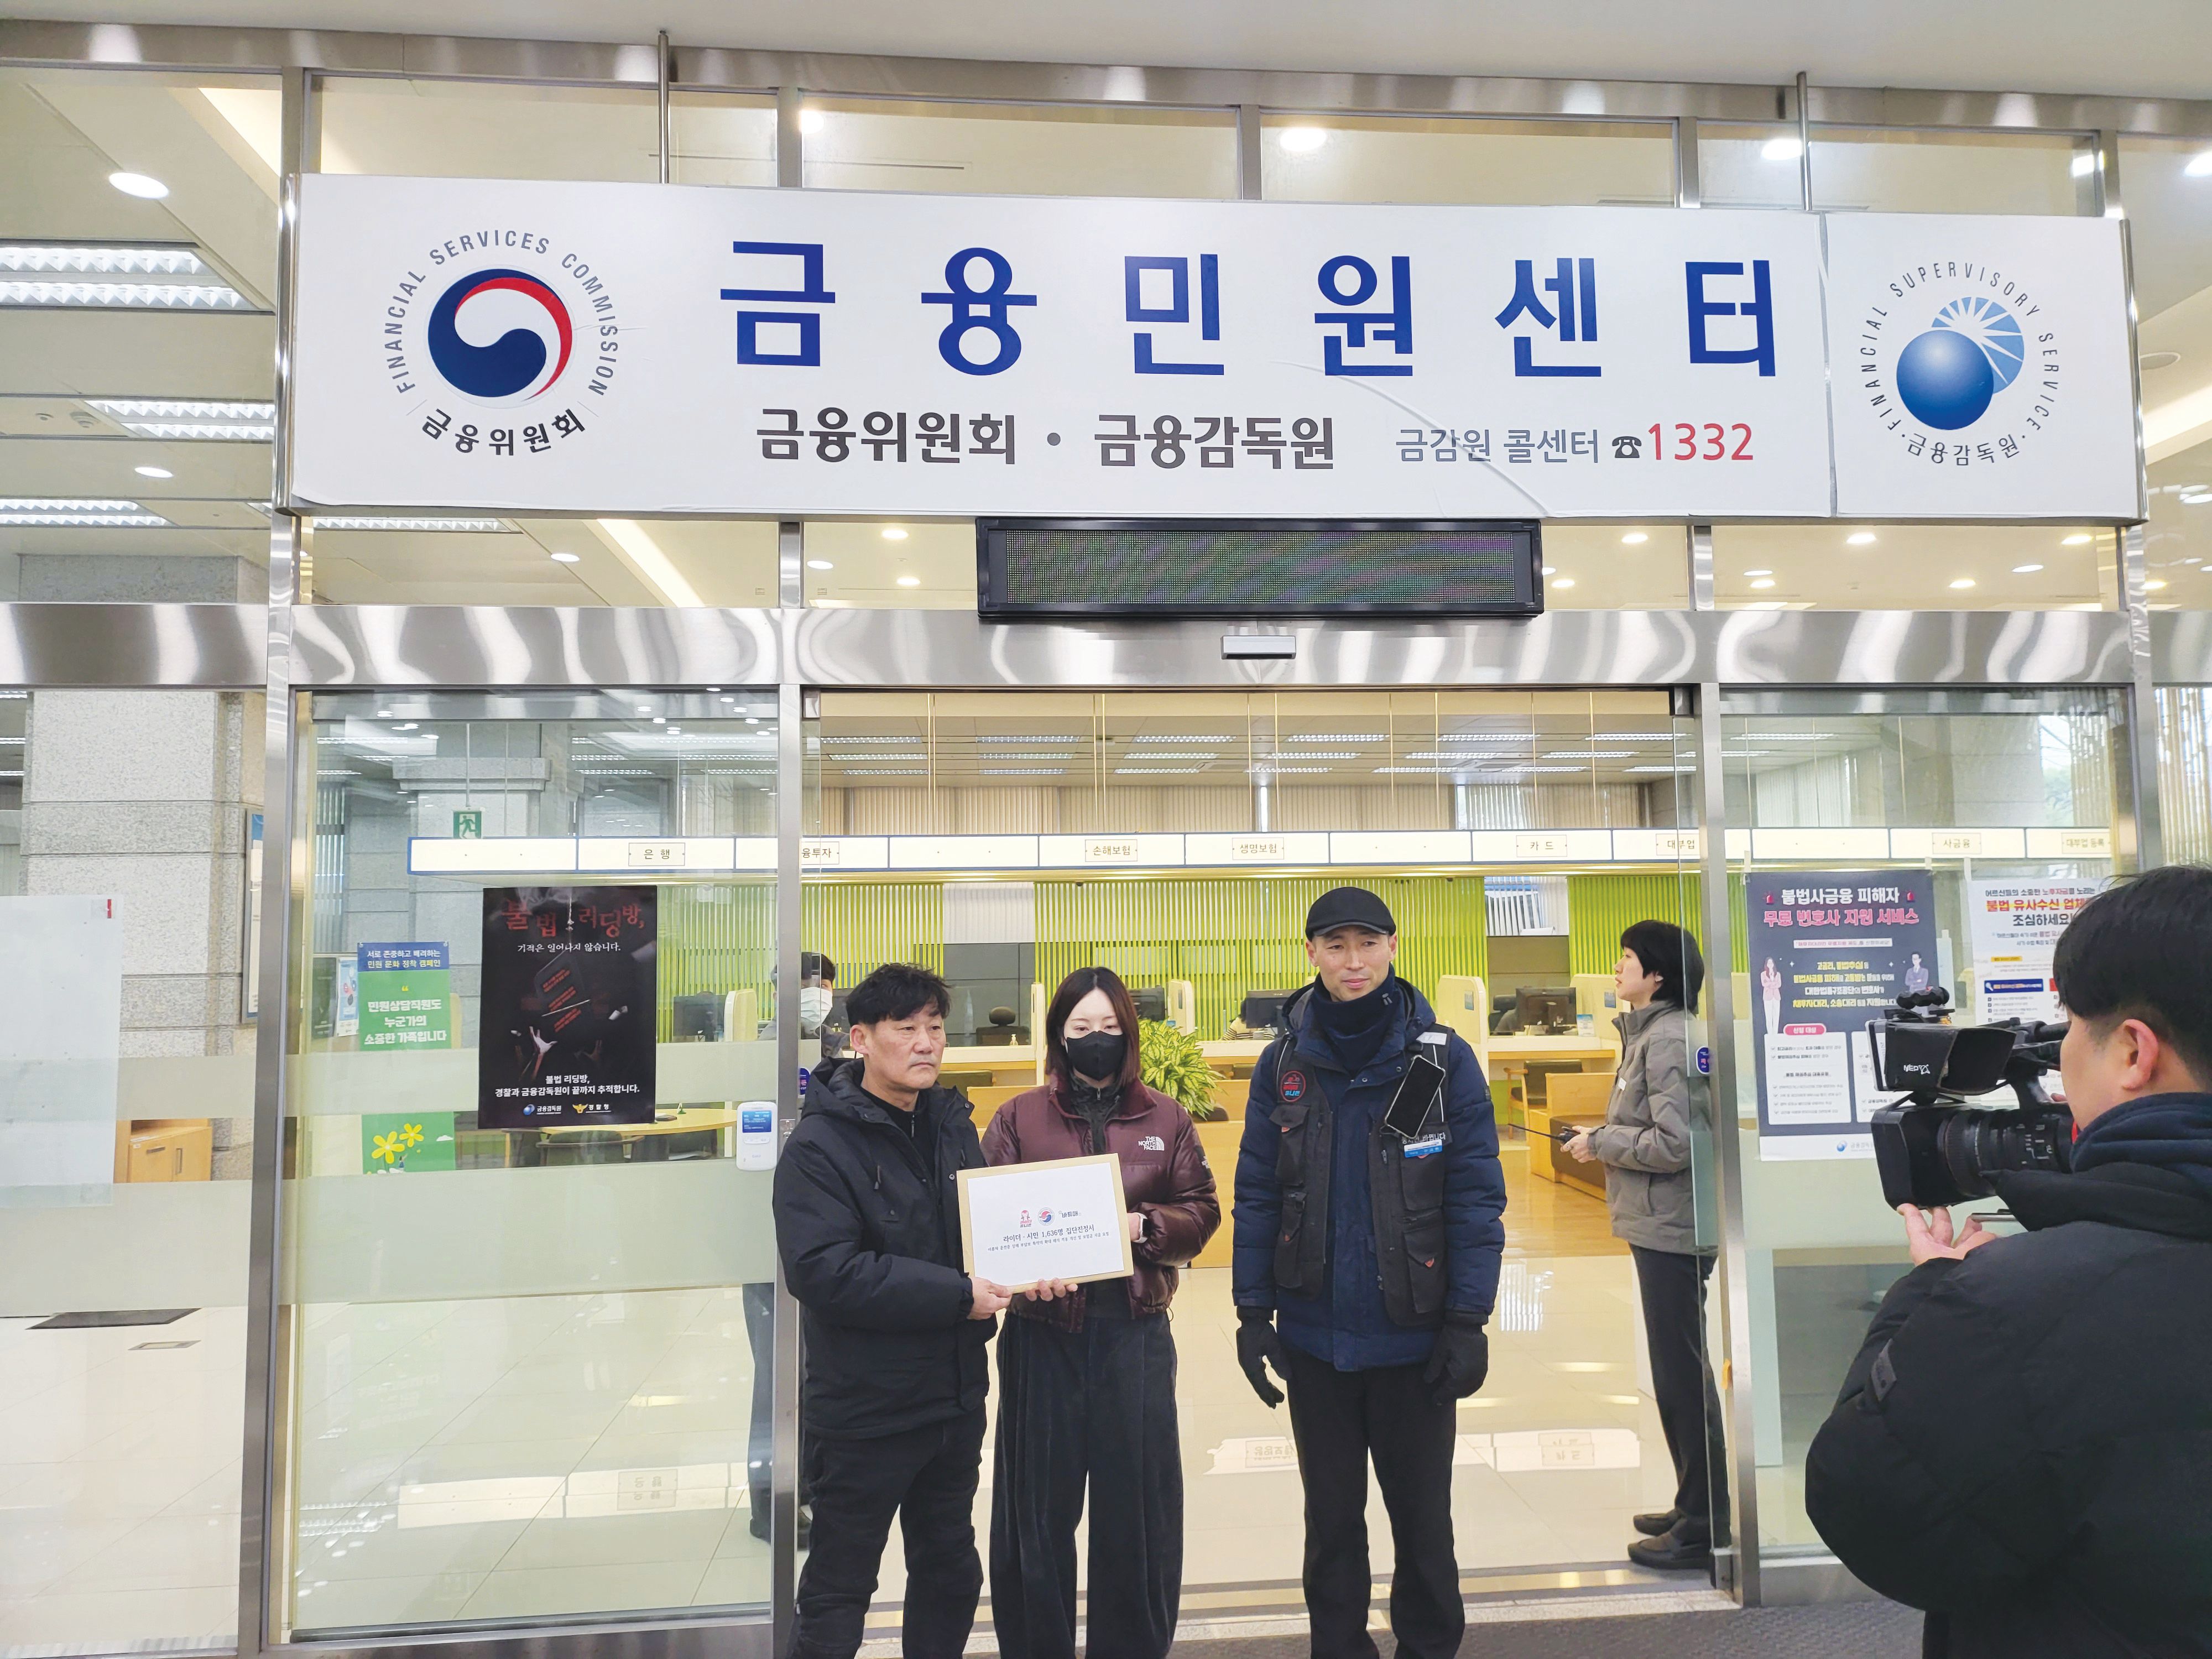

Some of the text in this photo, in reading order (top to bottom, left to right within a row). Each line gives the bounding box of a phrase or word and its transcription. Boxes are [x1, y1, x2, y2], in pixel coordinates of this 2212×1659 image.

[384, 229, 618, 398] FINANCIAL SERVICES COMMISSION
[720, 241, 1776, 377] 금융민원센터
[1860, 261, 2059, 431] FINANCIAL SUPERVISORY SERVICE
[421, 408, 586, 457] 금융위원회
[757, 406, 1016, 465] 금융위원회
[1094, 414, 1333, 470] 금융감독원
[1395, 422, 1754, 464] 금감원 콜센터 1332
[1907, 432, 2020, 466] 금융감독원
[1092, 844, 1131, 857] 손해보험
[1239, 842, 1278, 854] 생명보험
[1530, 839, 1555, 852] 카드
[1667, 839, 1695, 851] 대부업
[1943, 838, 1971, 849] 사금융
[643, 847, 671, 860] 은행
[801, 847, 832, 859] 융투자
[1781, 886, 1900, 905] 불법사금융 피해자
[1986, 900, 2010, 912] 불법
[2013, 898, 2060, 911] 유사수신
[502, 898, 556, 938] 불법
[1764, 908, 1919, 927] 무료 변호사 지원 서비스
[367, 950, 441, 958] 서로 존중하고 배려하는
[517, 942, 621, 953] 기적은 일어나지 않습니다.
[367, 999, 442, 1013] 민원상담직원도
[384, 1015, 427, 1028] 누군가의
[364, 1030, 447, 1045] 소중한 가족입니다
[545, 1074, 590, 1084] 불법 리딩방,
[495, 1084, 640, 1098] 경찰과 금융감독원이 끝까지 추적합니다.
[1003, 1234, 1021, 1243] 라이더
[1041, 1228, 1063, 1238] 1,636명
[1066, 1224, 1094, 1235] 집단진정서
